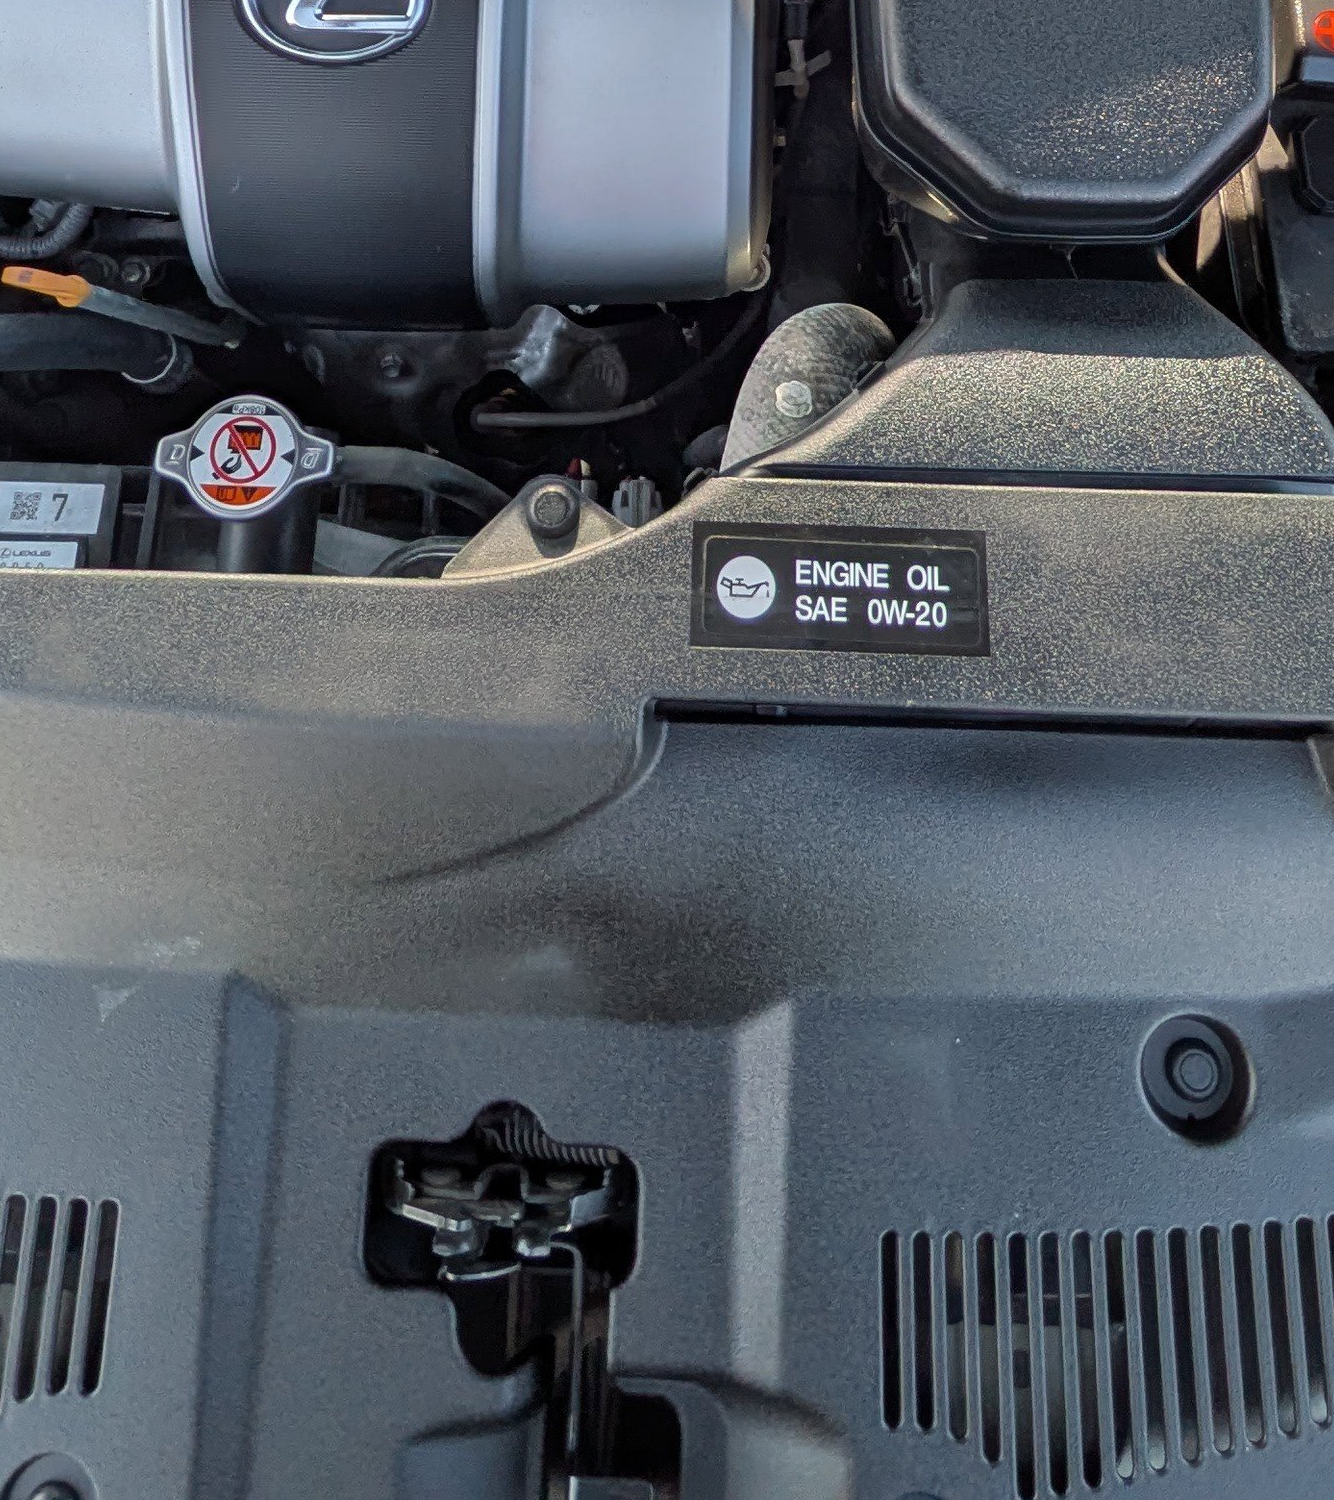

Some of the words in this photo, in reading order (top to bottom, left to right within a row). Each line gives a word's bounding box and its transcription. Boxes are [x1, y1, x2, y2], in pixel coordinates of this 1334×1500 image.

[51, 493, 69, 523] 7
[12, 549, 52, 558] LEXUS
[794, 559, 890, 589] ENGINE
[906, 564, 951, 592] OIL
[794, 594, 848, 623] SAE
[866, 600, 948, 628] 0W-20
